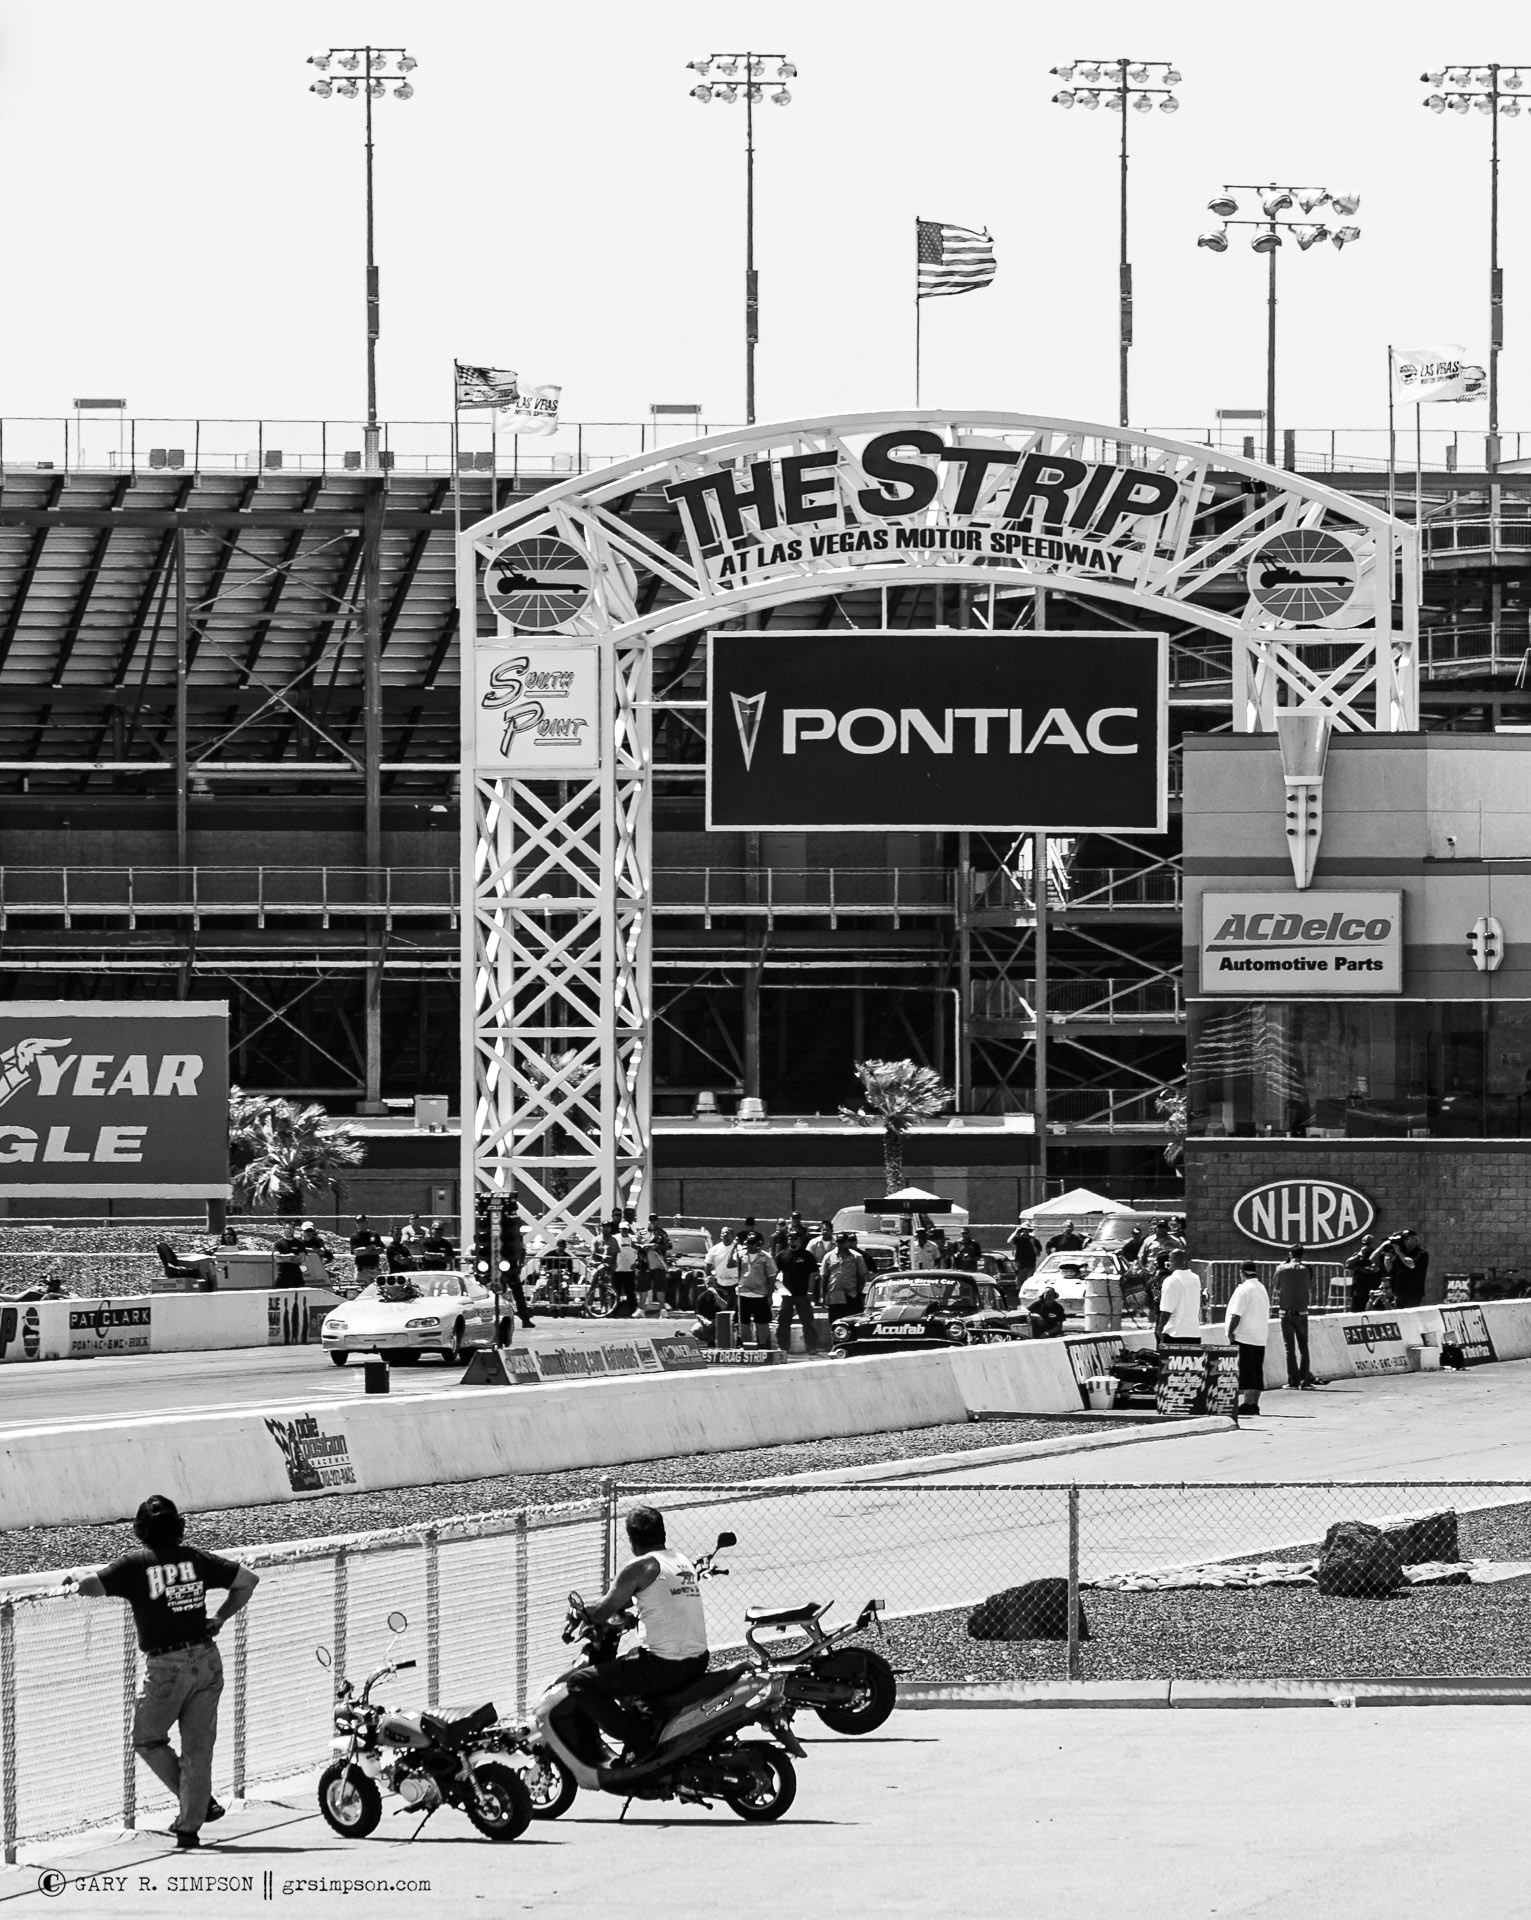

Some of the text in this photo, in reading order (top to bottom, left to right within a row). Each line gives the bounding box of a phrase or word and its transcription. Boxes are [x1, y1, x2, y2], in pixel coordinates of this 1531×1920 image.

[663, 429, 1179, 549] THE STRIP
[719, 528, 1124, 578] AT LAS VEGAS MOTOR SPEEDWAY
[782, 707, 1138, 754] PONTIAC
[1213, 912, 1392, 941] ACDelco
[1219, 956, 1384, 971] Automotive Parts
[1252, 1186, 1359, 1243] NHRA
[71, 1310, 150, 1327] PAT CLARK
[872, 1324, 926, 1335] Accufab
[1344, 1324, 1400, 1344] PAT CLARK
[720, 1352, 741, 1363] DRAG
[743, 1352, 767, 1363] STRIP
[146, 1561, 197, 1600] HPH
